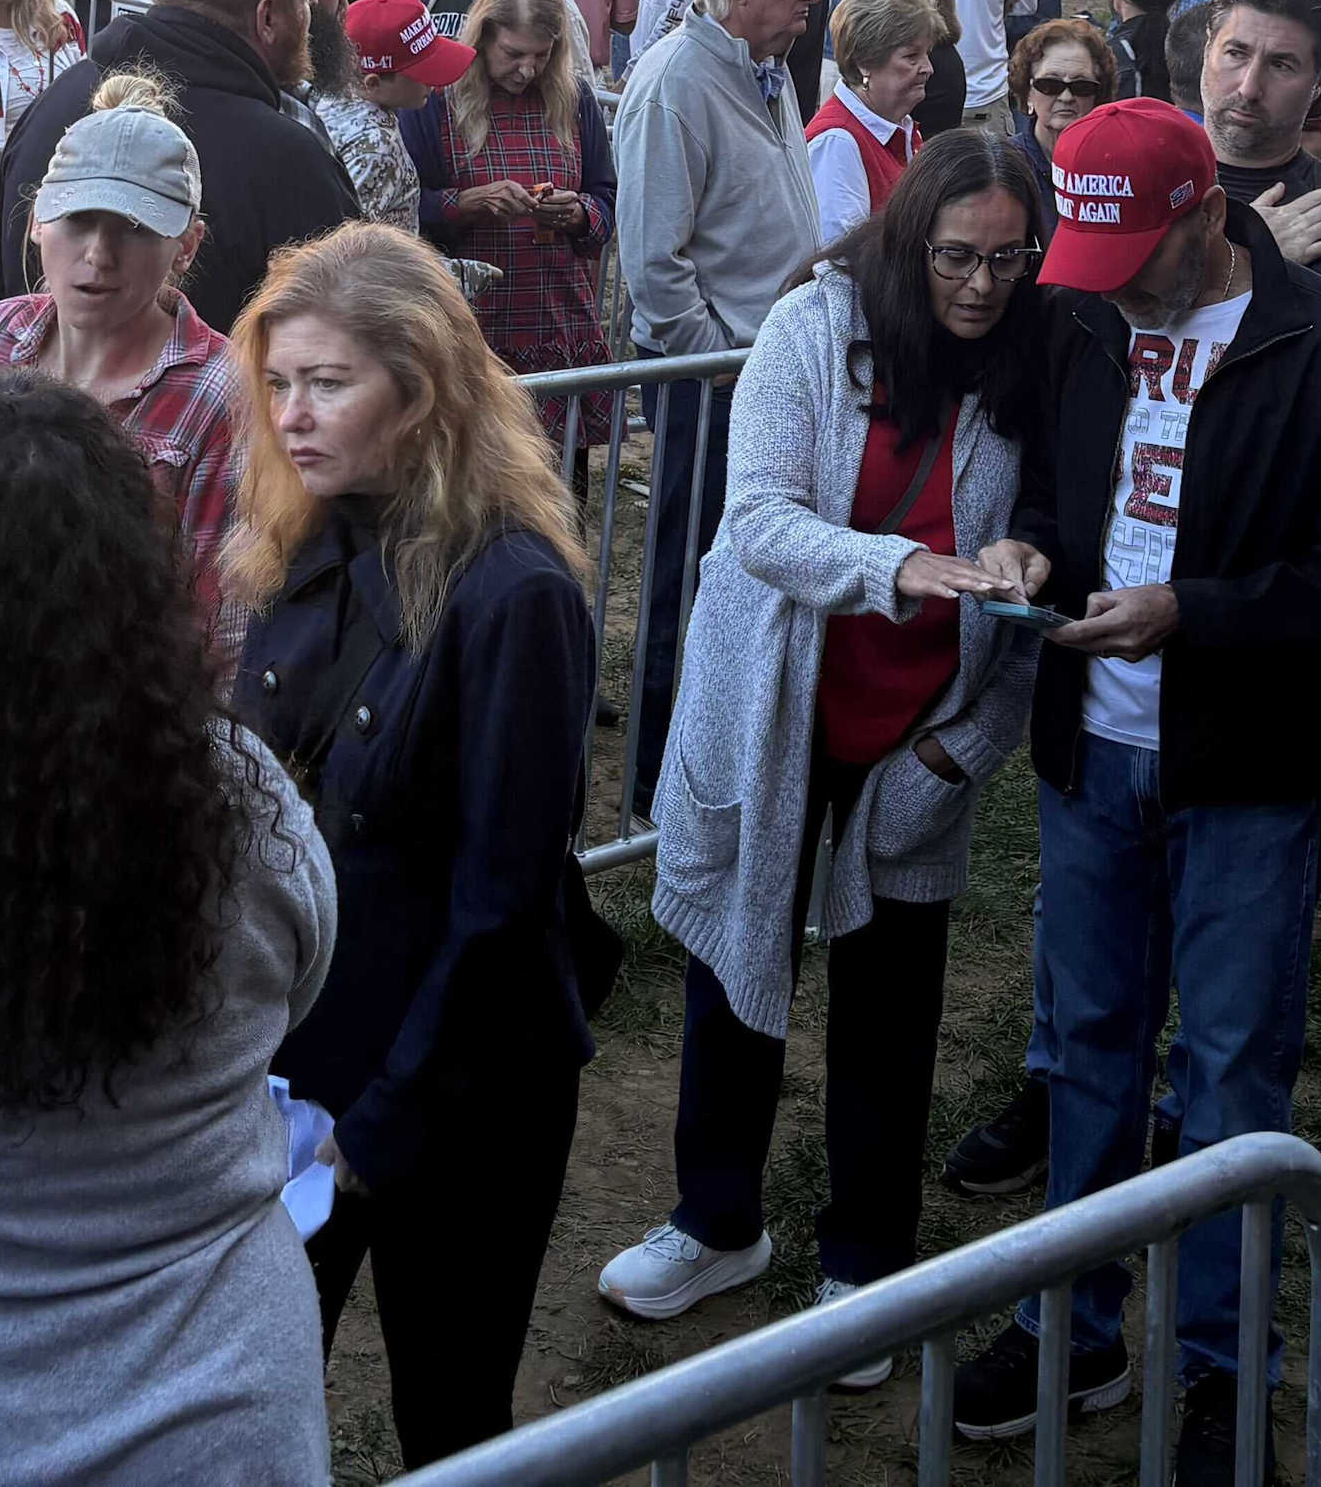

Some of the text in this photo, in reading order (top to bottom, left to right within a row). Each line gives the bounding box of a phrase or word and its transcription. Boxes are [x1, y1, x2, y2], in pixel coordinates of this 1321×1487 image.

[361, 55, 393, 69] 45-47
[1066, 171, 1135, 198] AMERICA
[1078, 201, 1121, 225] AGAIN
